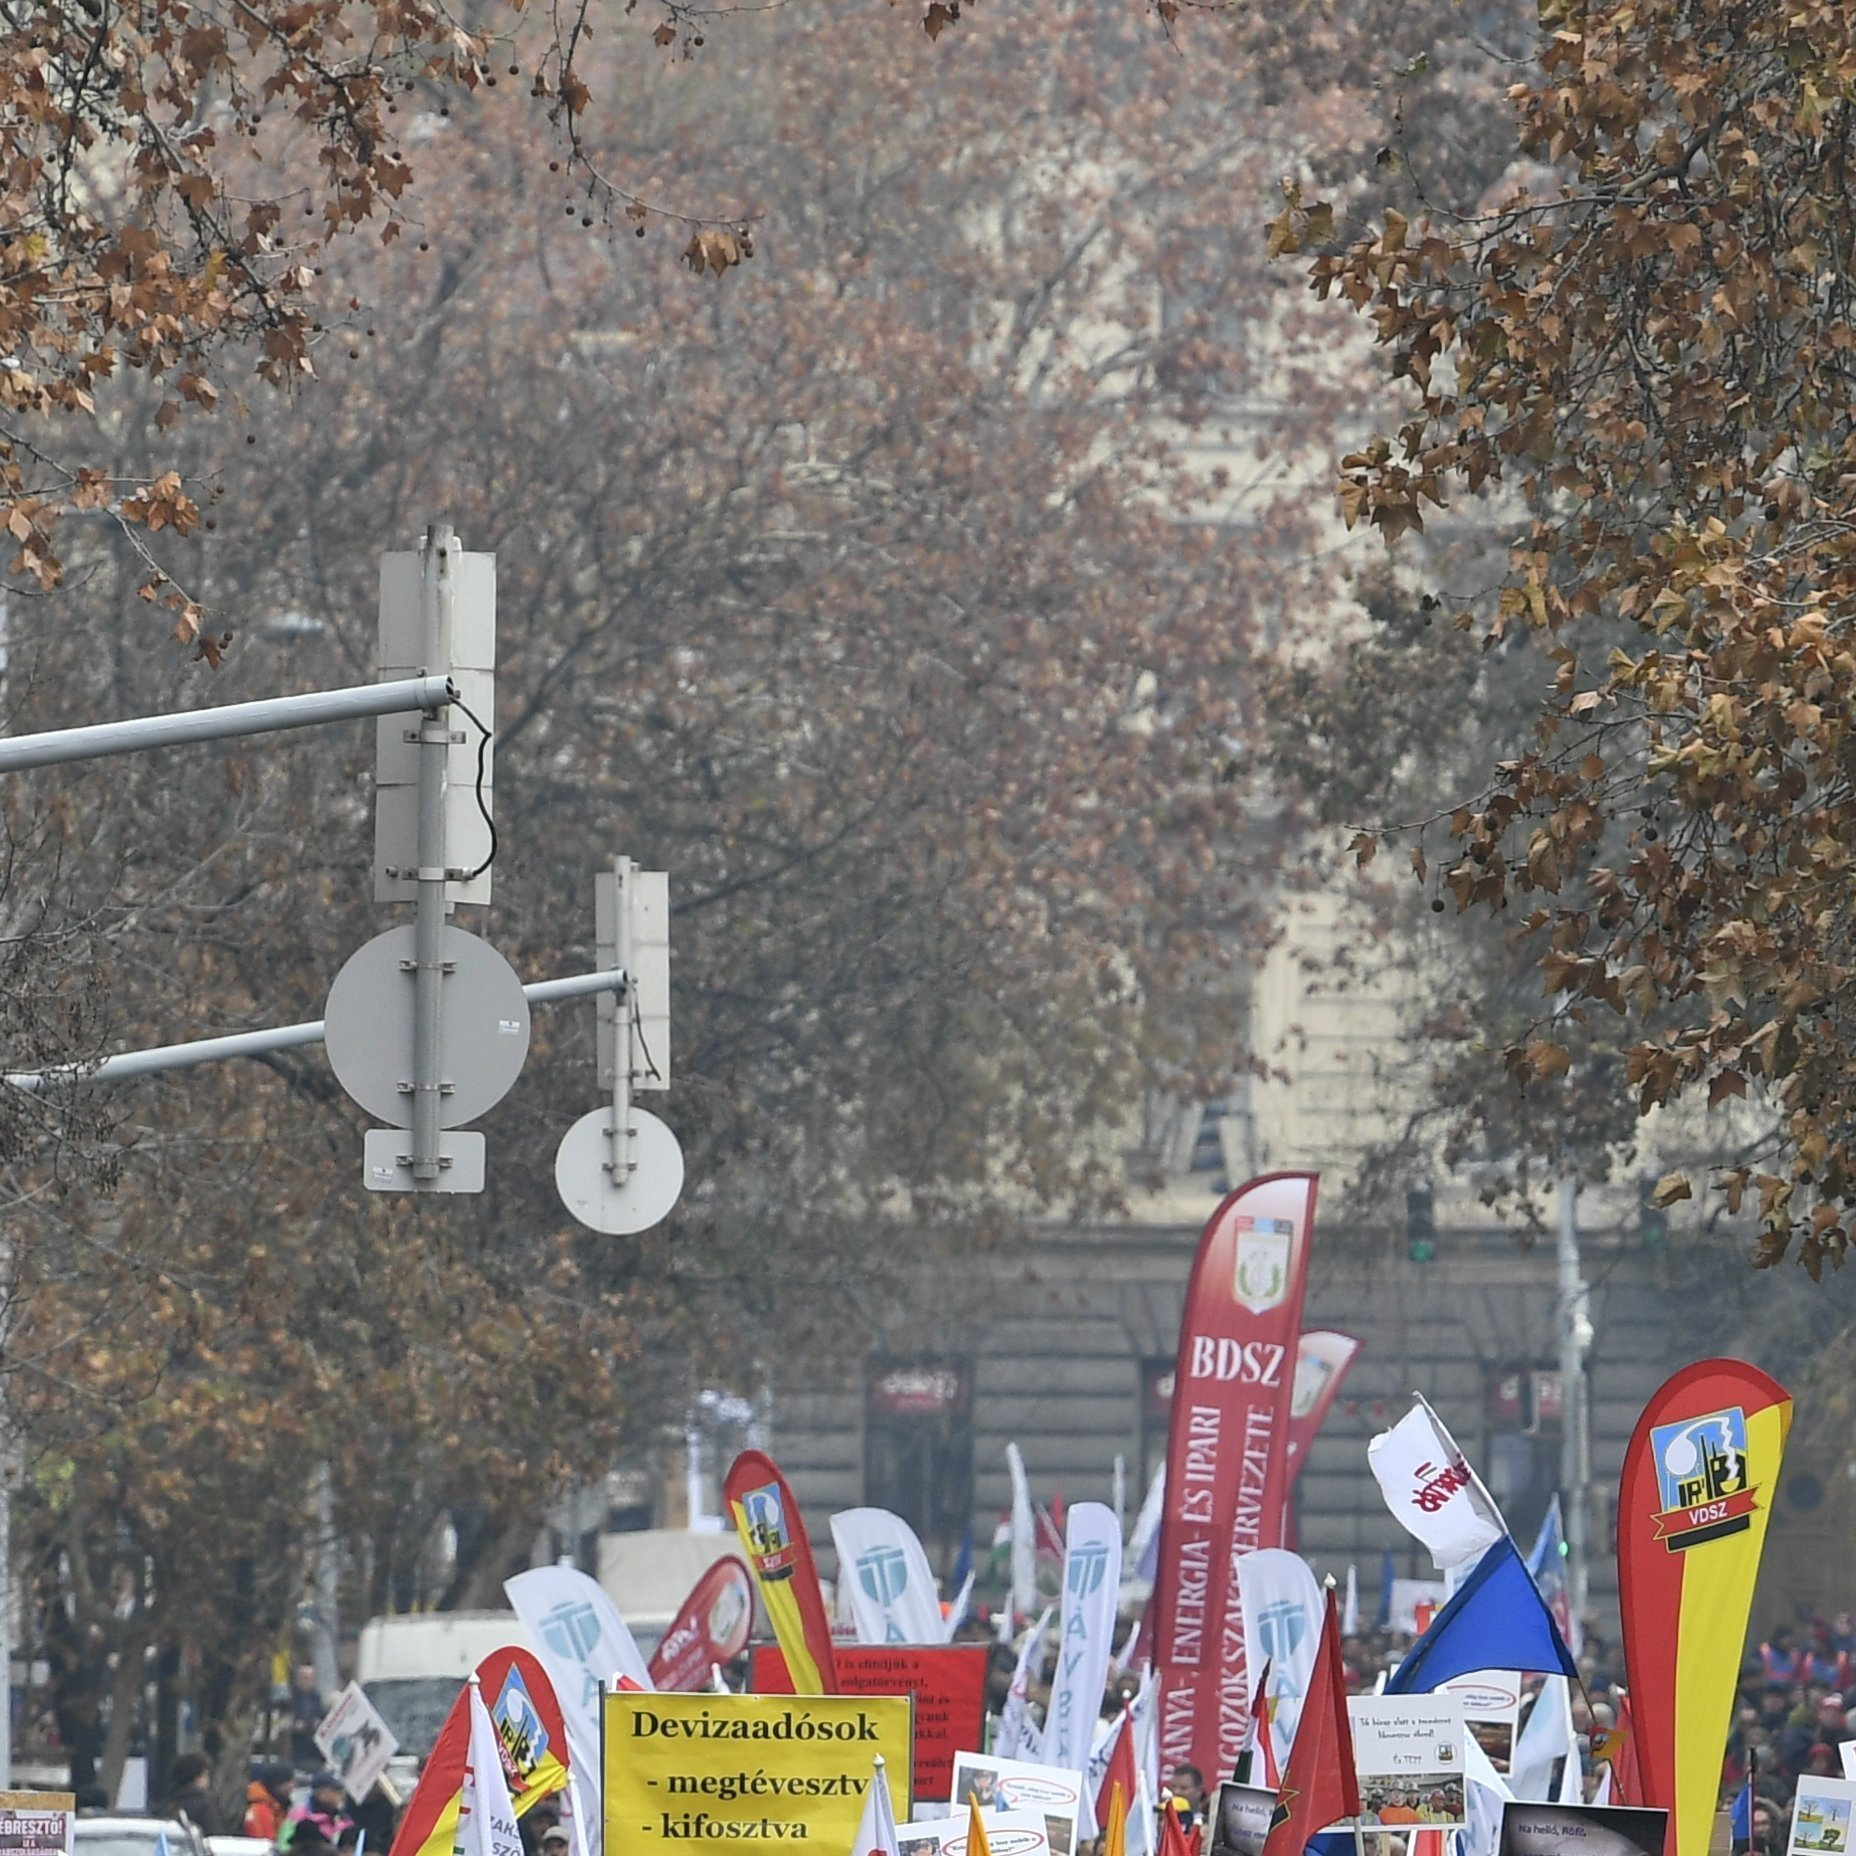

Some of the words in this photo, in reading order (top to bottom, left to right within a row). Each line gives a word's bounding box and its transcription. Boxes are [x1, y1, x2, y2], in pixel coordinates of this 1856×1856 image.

[1190, 1335, 1285, 1388] BDSZ
[1185, 1405, 1223, 1482] IPARI
[1688, 1501, 1729, 1525] VDSZ
[631, 1711, 879, 1741] Devizaadósok
[667, 1769, 870, 1801] megtévesztv
[660, 1813, 808, 1840] kifosztva
